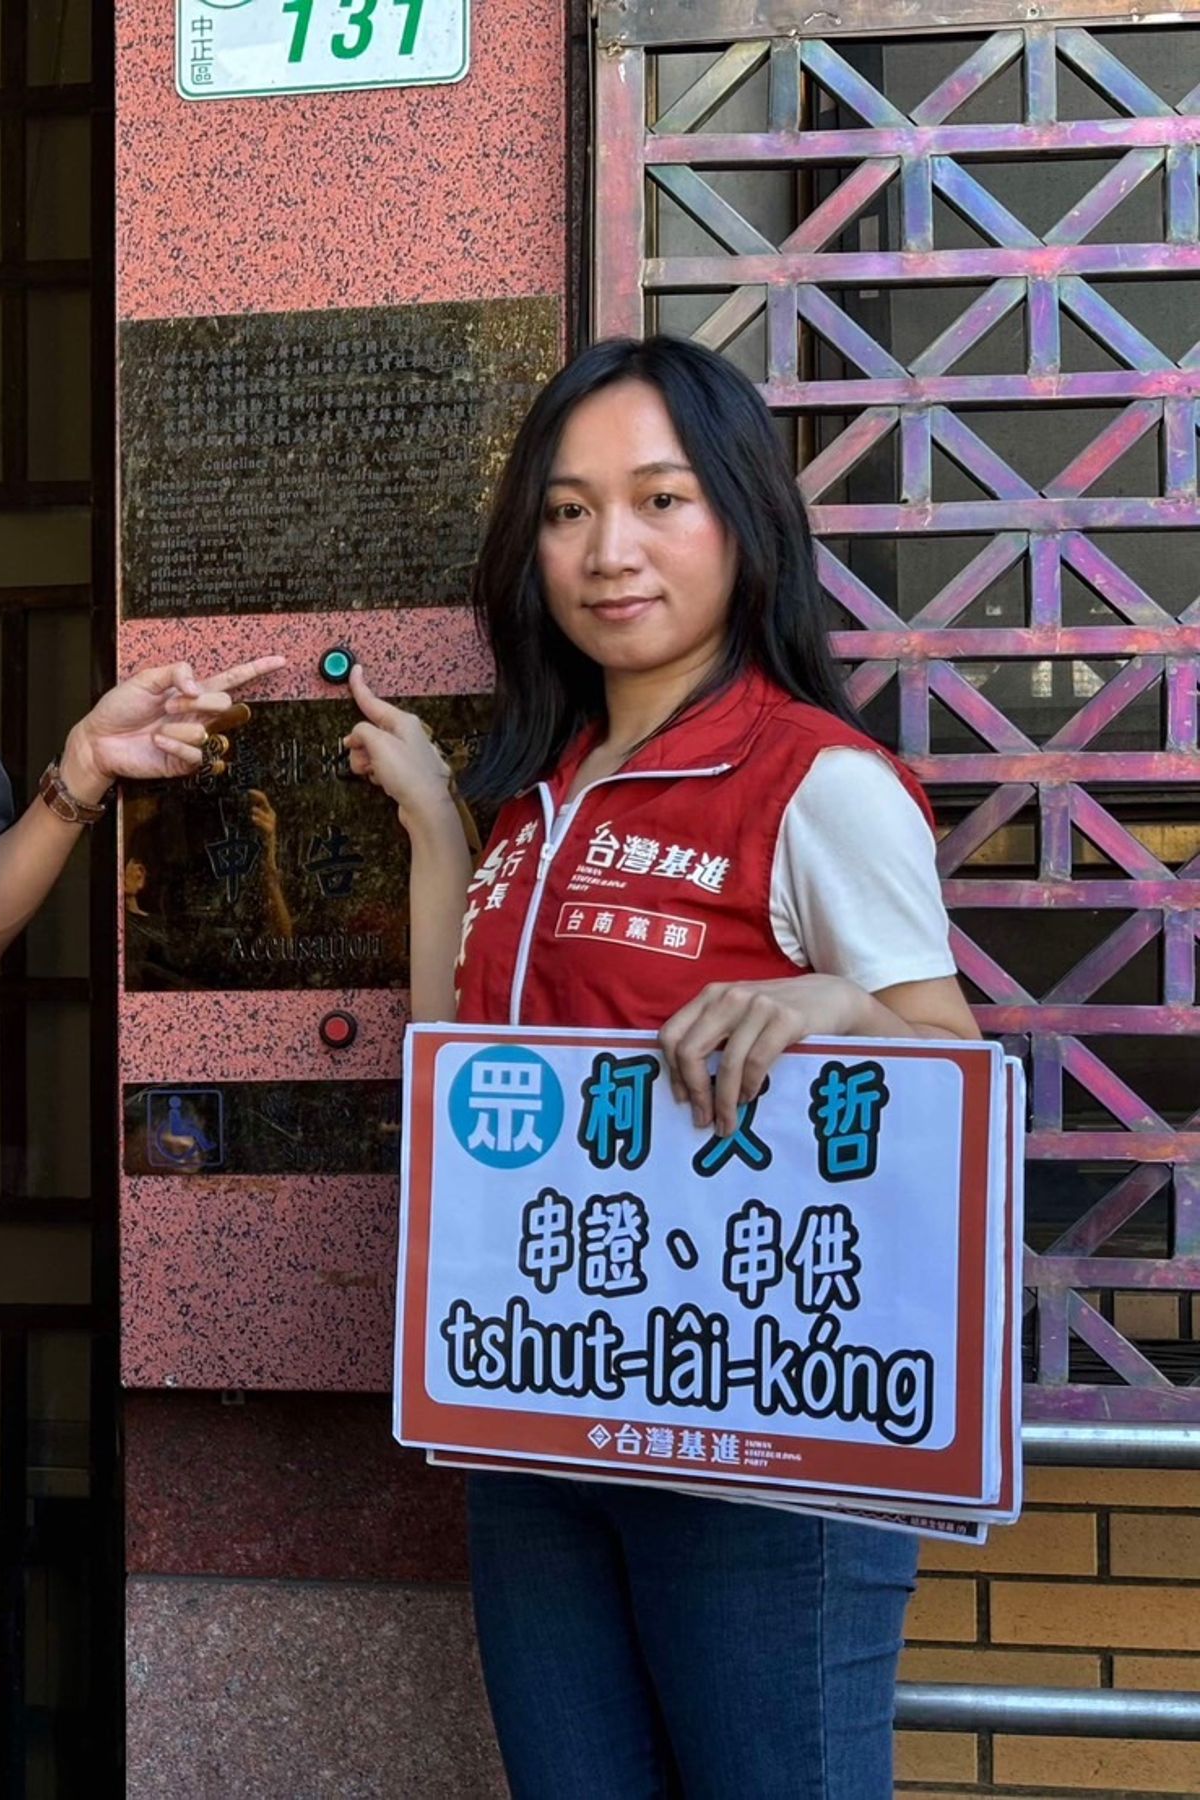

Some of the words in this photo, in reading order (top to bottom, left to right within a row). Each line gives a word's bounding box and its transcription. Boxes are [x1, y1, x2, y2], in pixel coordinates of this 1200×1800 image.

[191, 15, 214, 85] 中正區
[282, 0, 426, 63] 131
[484, 820, 539, 910] 執行長
[585, 821, 731, 895] 台灣基進
[566, 909, 689, 949] 台南黨部
[518, 1186, 864, 1316] 串證、串供
[441, 1296, 936, 1446] tshut-lâi-kóng
[613, 1422, 742, 1466] 台灣基進
